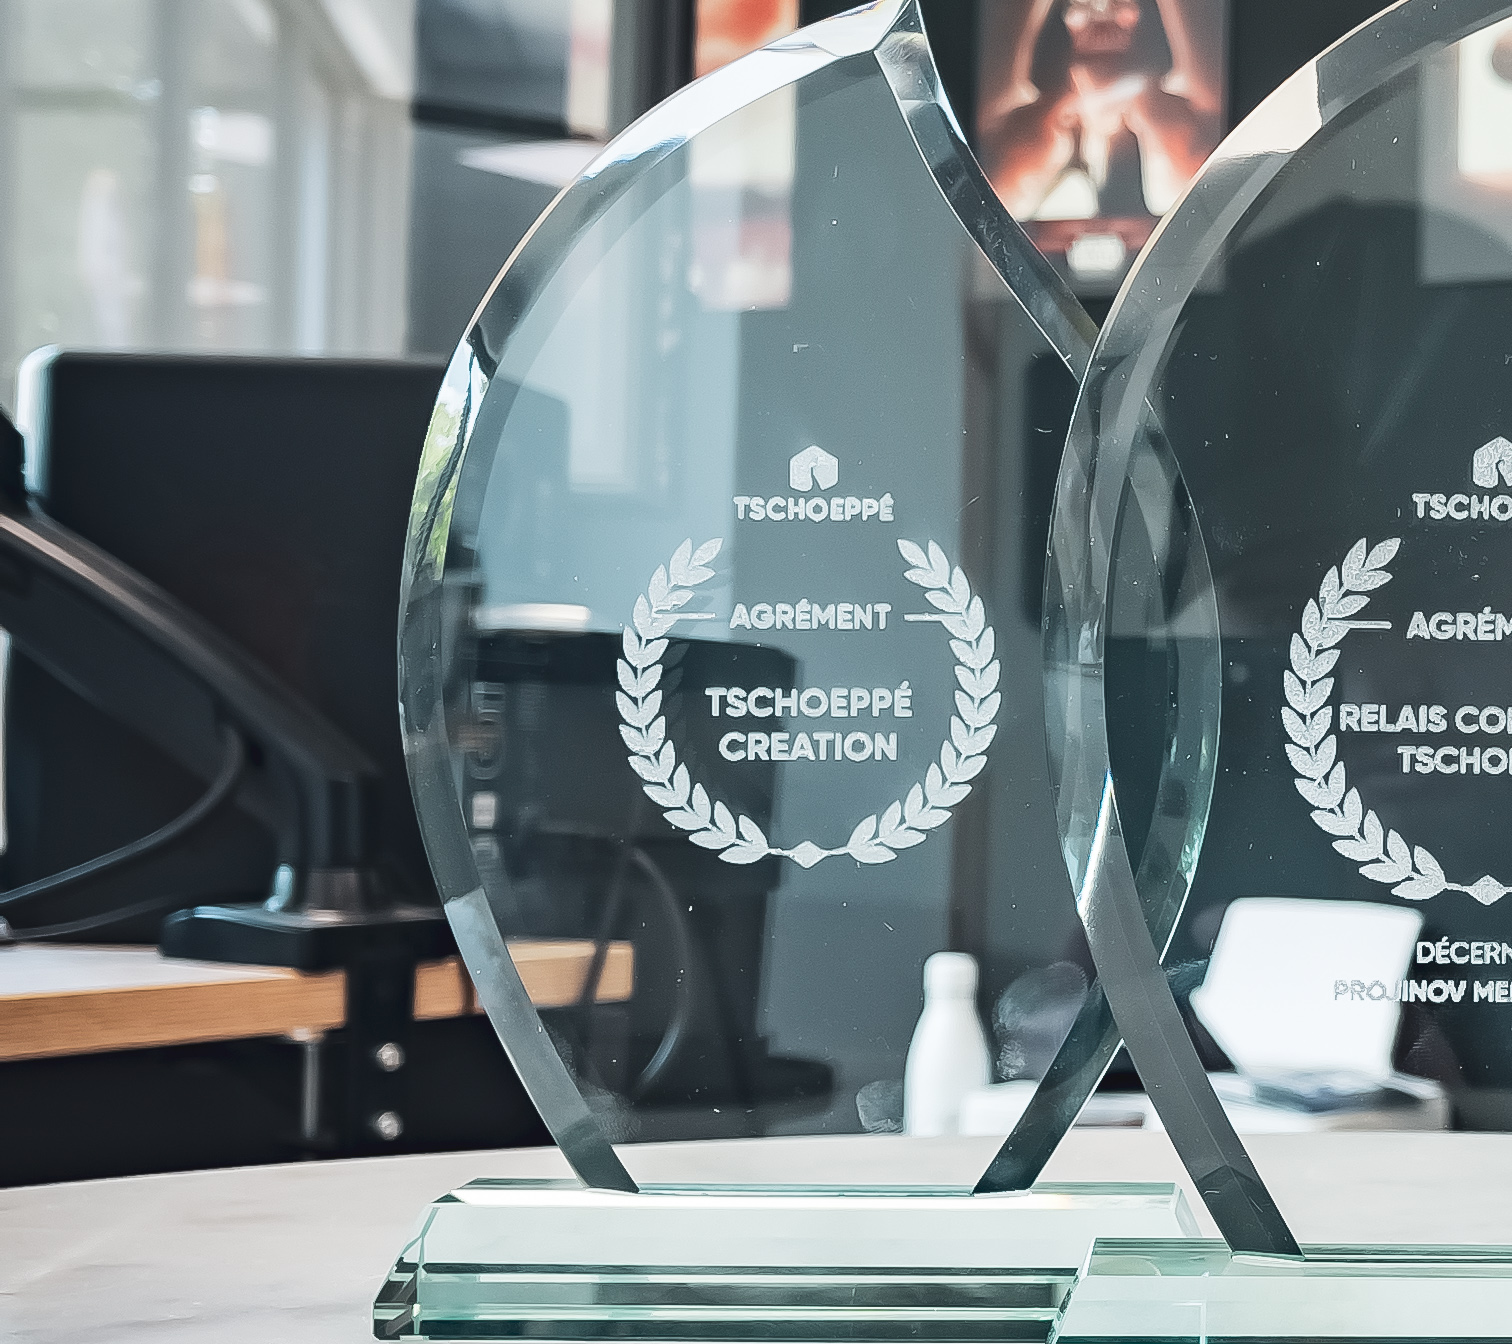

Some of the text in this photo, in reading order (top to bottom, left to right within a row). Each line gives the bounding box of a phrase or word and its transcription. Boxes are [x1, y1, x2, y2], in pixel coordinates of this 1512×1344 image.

[733, 493, 895, 522] TSCHOEPPÉ
[729, 598, 891, 630] AGRÉMENT
[705, 681, 913, 717] TSCHOEPPÉ
[1339, 703, 1447, 734] RELAIS
[718, 732, 898, 762] CREATION
[1334, 979, 1467, 1003] PROJINOV
